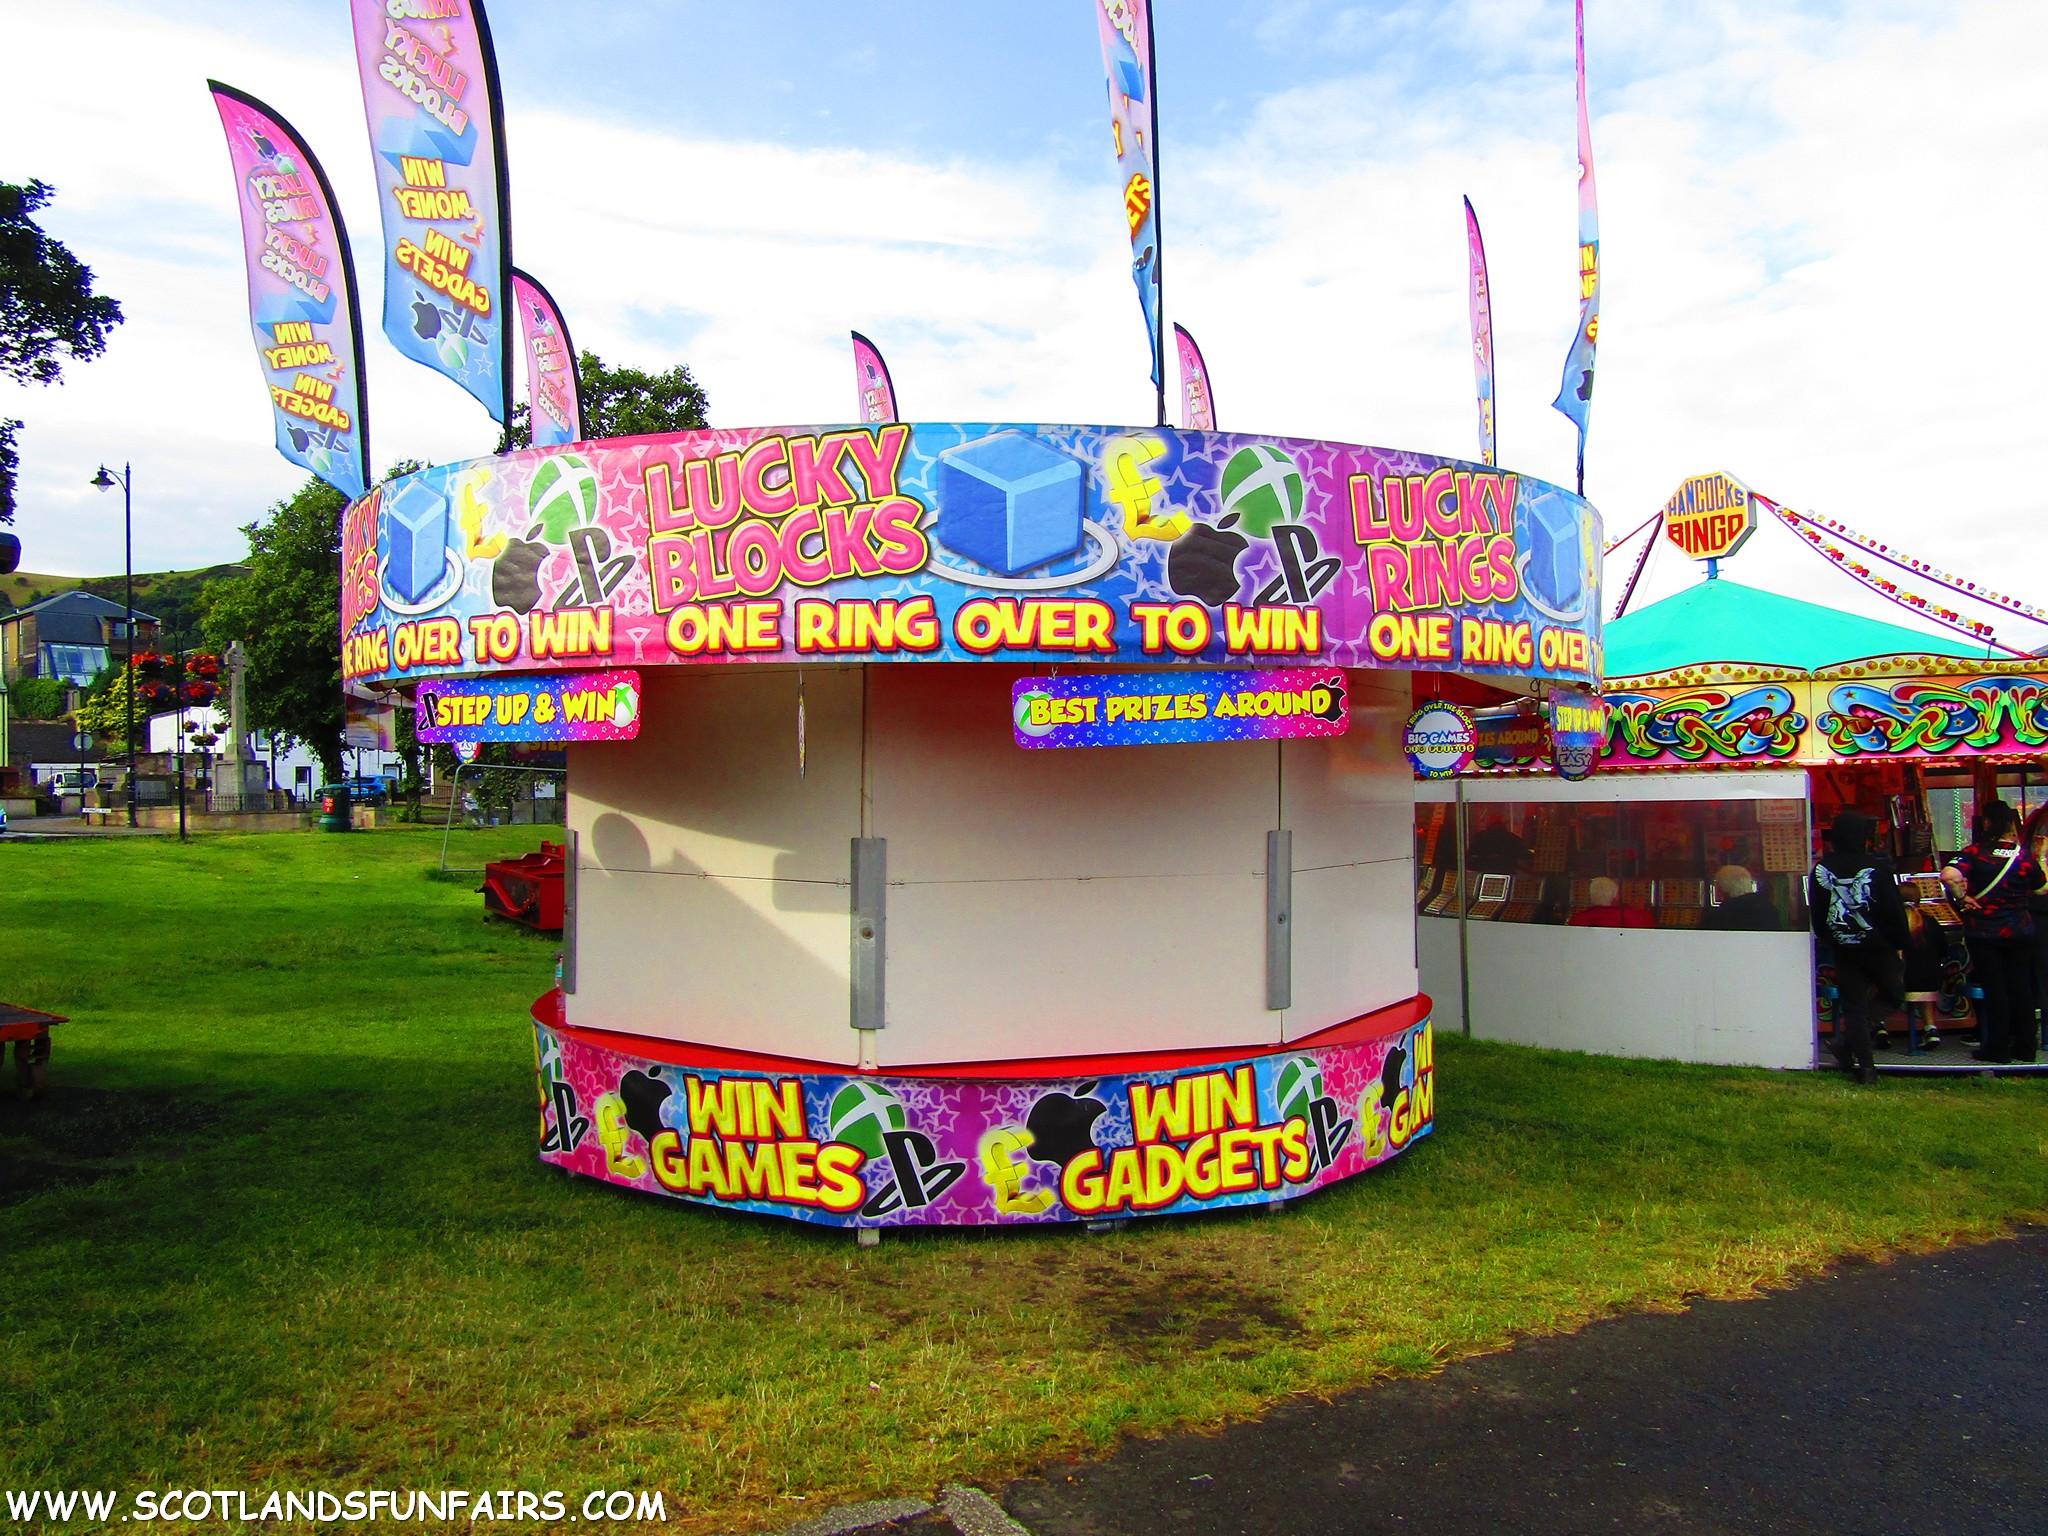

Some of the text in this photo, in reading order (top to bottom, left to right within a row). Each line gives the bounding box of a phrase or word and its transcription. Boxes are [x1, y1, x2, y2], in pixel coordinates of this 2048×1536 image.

[645, 425, 908, 533] LUCKY
[1349, 468, 1517, 544] LUCKY
[1667, 475, 1744, 516] HANCOCKS
[647, 494, 929, 614] BLOCKS
[1667, 514, 1743, 553] BINGO
[1368, 534, 1519, 613] RINGS
[355, 625, 389, 675] RING
[393, 616, 462, 672] OVER
[470, 616, 522, 664] TO
[527, 606, 613, 658] WIN
[664, 594, 1324, 657] ONE RING OVER TO WIN
[1368, 612, 1452, 662] ONE
[1461, 616, 1534, 668] RING
[1539, 626, 1589, 672] OVER
[436, 689, 616, 728] STEP UP & WIN
[1029, 688, 1331, 725] BEST PRIZES AROUND
[1408, 709, 1424, 726] RING
[1423, 702, 1443, 712] OVER
[1443, 703, 1457, 713] THE
[1456, 709, 1474, 730] BLOCK
[1497, 728, 1539, 745] AROUND
[1404, 744, 1475, 754] BIG PRIZES
[1407, 732, 1470, 744] BIG GAMES
[1559, 753, 1592, 768] EASY
[1429, 768, 1454, 778] TO WIN
[683, 1073, 807, 1142] WIN
[1129, 1064, 1258, 1147] WIN
[649, 1129, 866, 1214] GAMES
[1060, 1116, 1310, 1216] GADGETS
